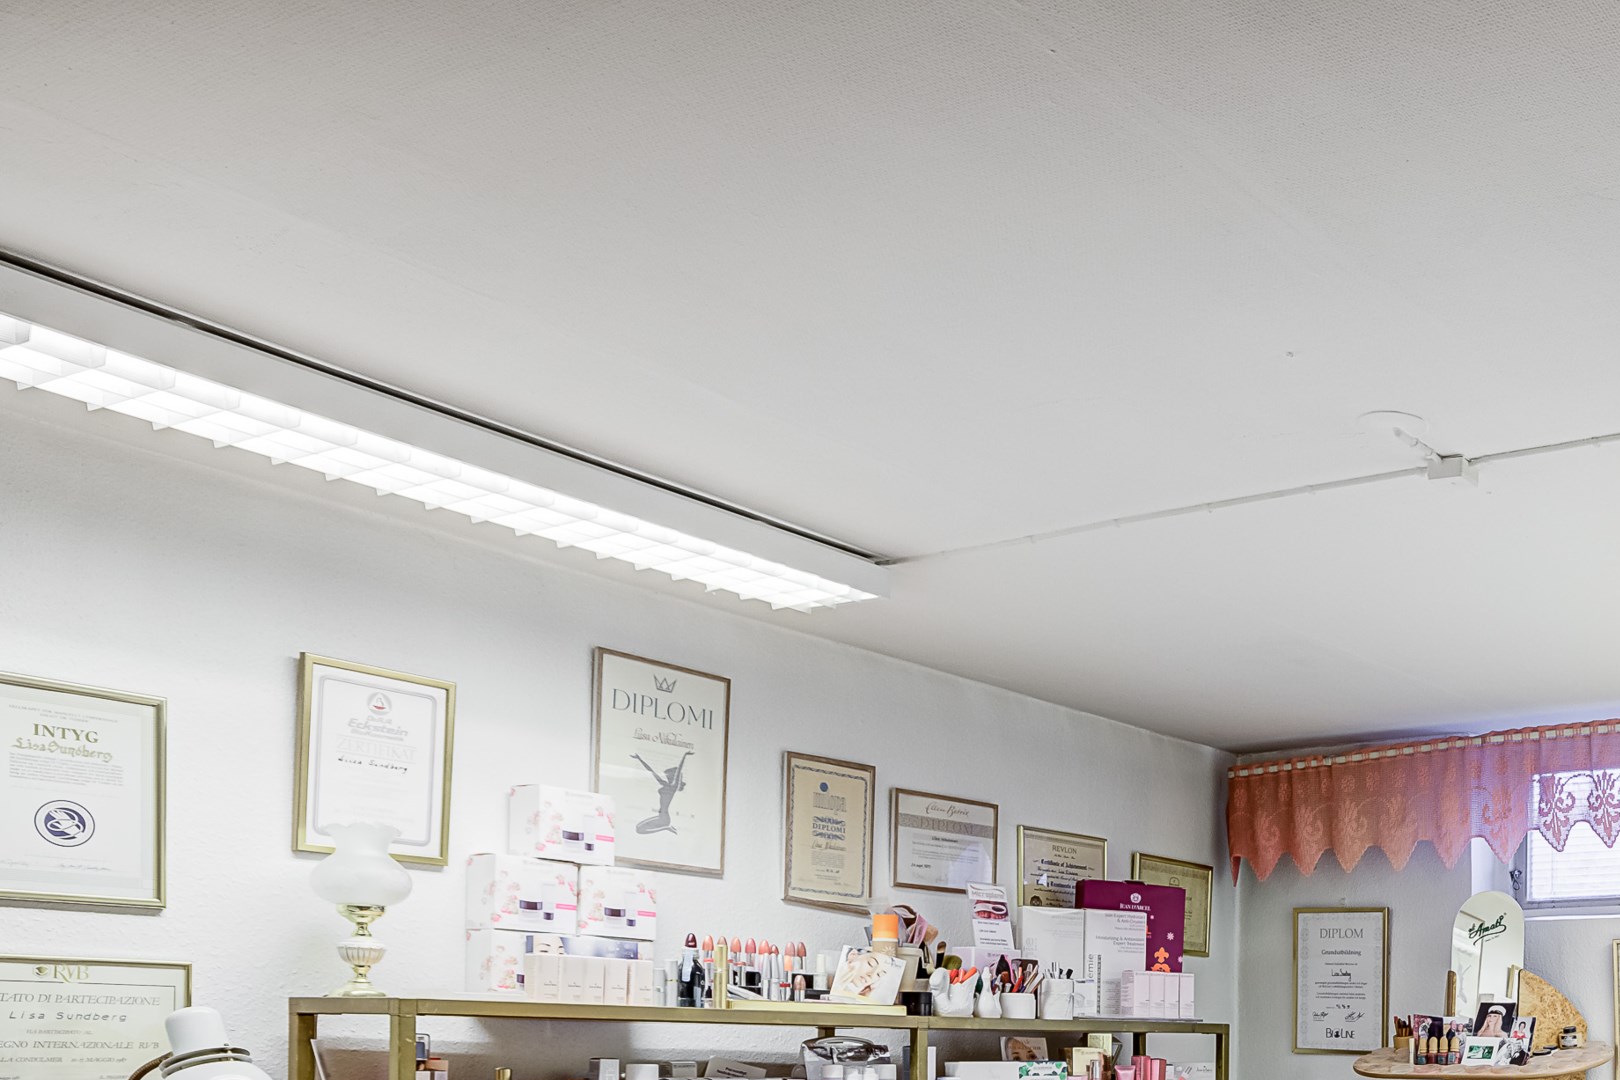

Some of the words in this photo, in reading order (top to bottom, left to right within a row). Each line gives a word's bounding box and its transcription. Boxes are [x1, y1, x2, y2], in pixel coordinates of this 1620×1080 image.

[612, 688, 713, 730] DIPLOMI
[348, 717, 409, 737] Eckstein
[32, 723, 99, 744] INTYG
[812, 822, 846, 833] DIPLOMI
[1052, 844, 1077, 854] REVLON
[1319, 928, 1364, 939] DIPLOM
[52, 965, 90, 983] RVB
[37, 993, 51, 1003] DI
[54, 994, 160, 1006] PARTECIPAZIONE
[9, 1010, 45, 1020] Lisa
[56, 1011, 127, 1022] Sundberg
[0, 1040, 28, 1049] EGNO
[33, 1040, 134, 1049] INTERNAZIONALE
